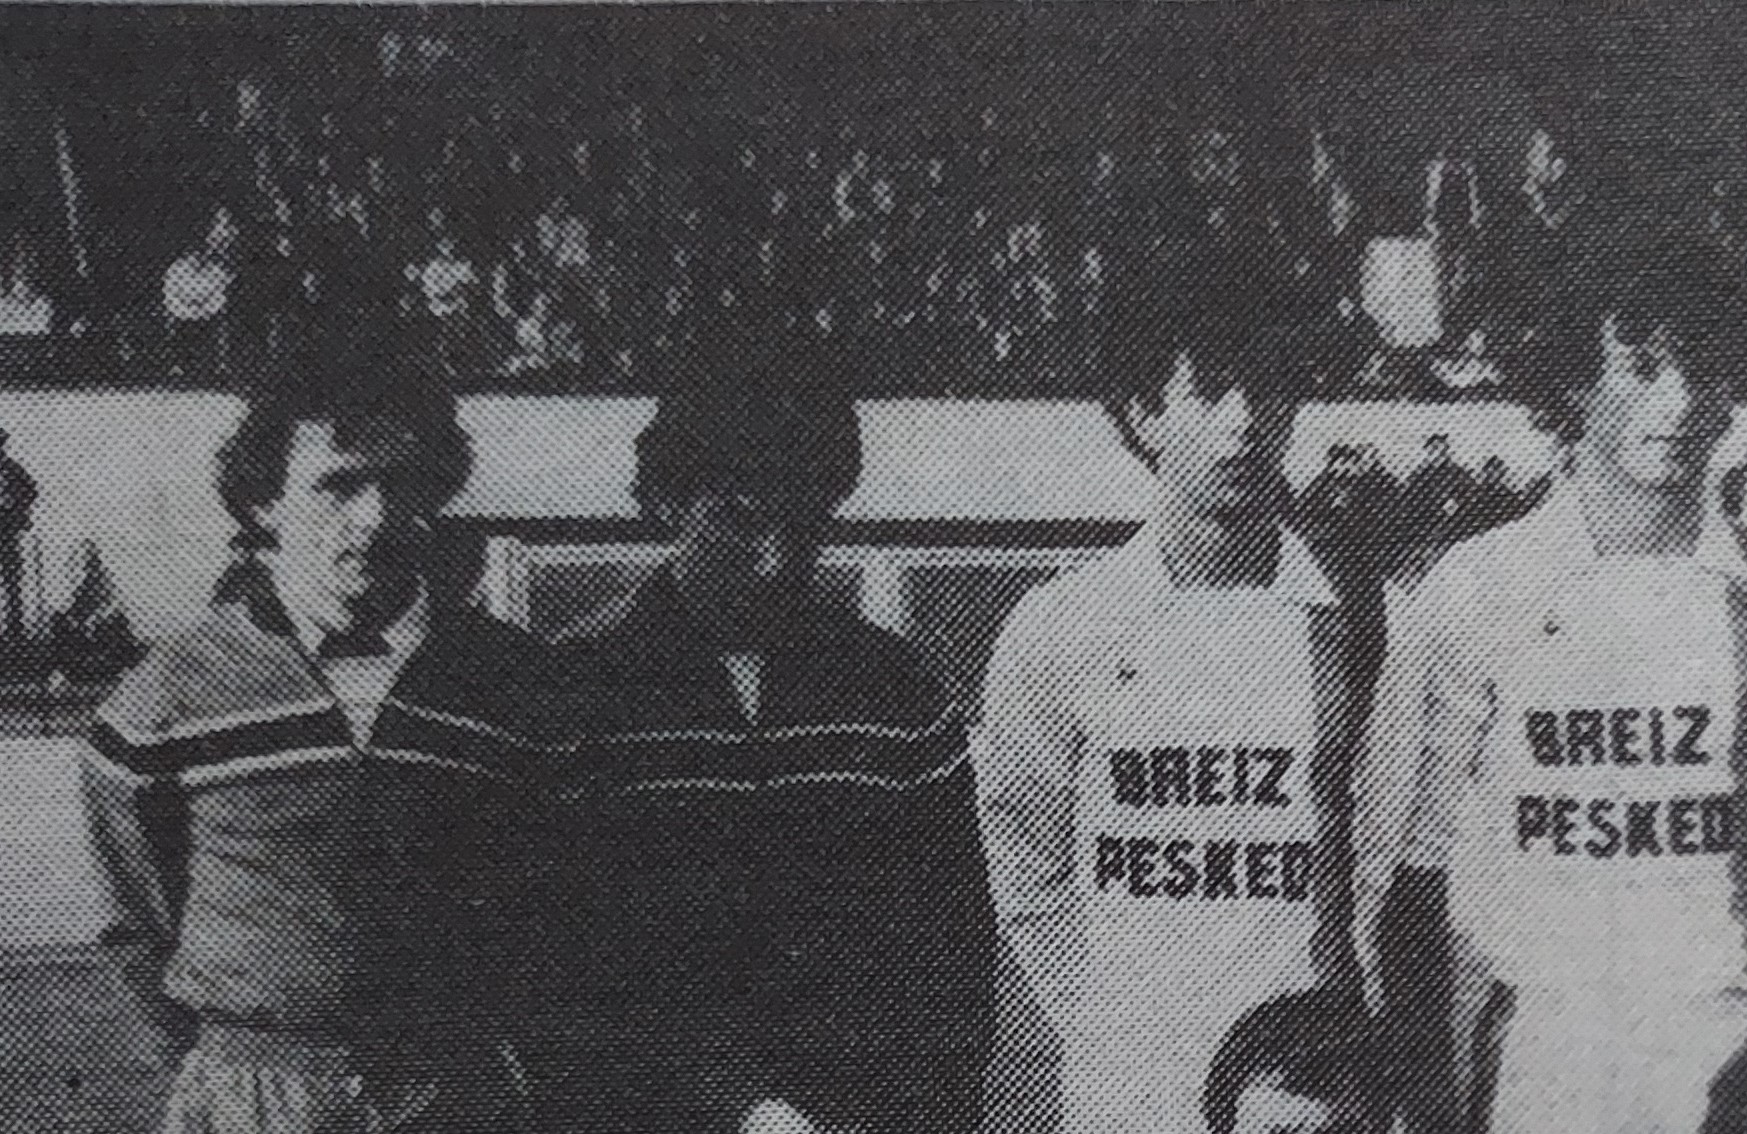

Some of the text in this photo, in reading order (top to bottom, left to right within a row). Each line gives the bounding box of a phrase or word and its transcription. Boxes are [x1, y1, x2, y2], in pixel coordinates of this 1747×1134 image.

[1524, 705, 1711, 767] BREIZ
[1109, 746, 1294, 807] BREIZ
[1515, 796, 1733, 857] PESKED
[1095, 835, 1314, 901] PESKED
